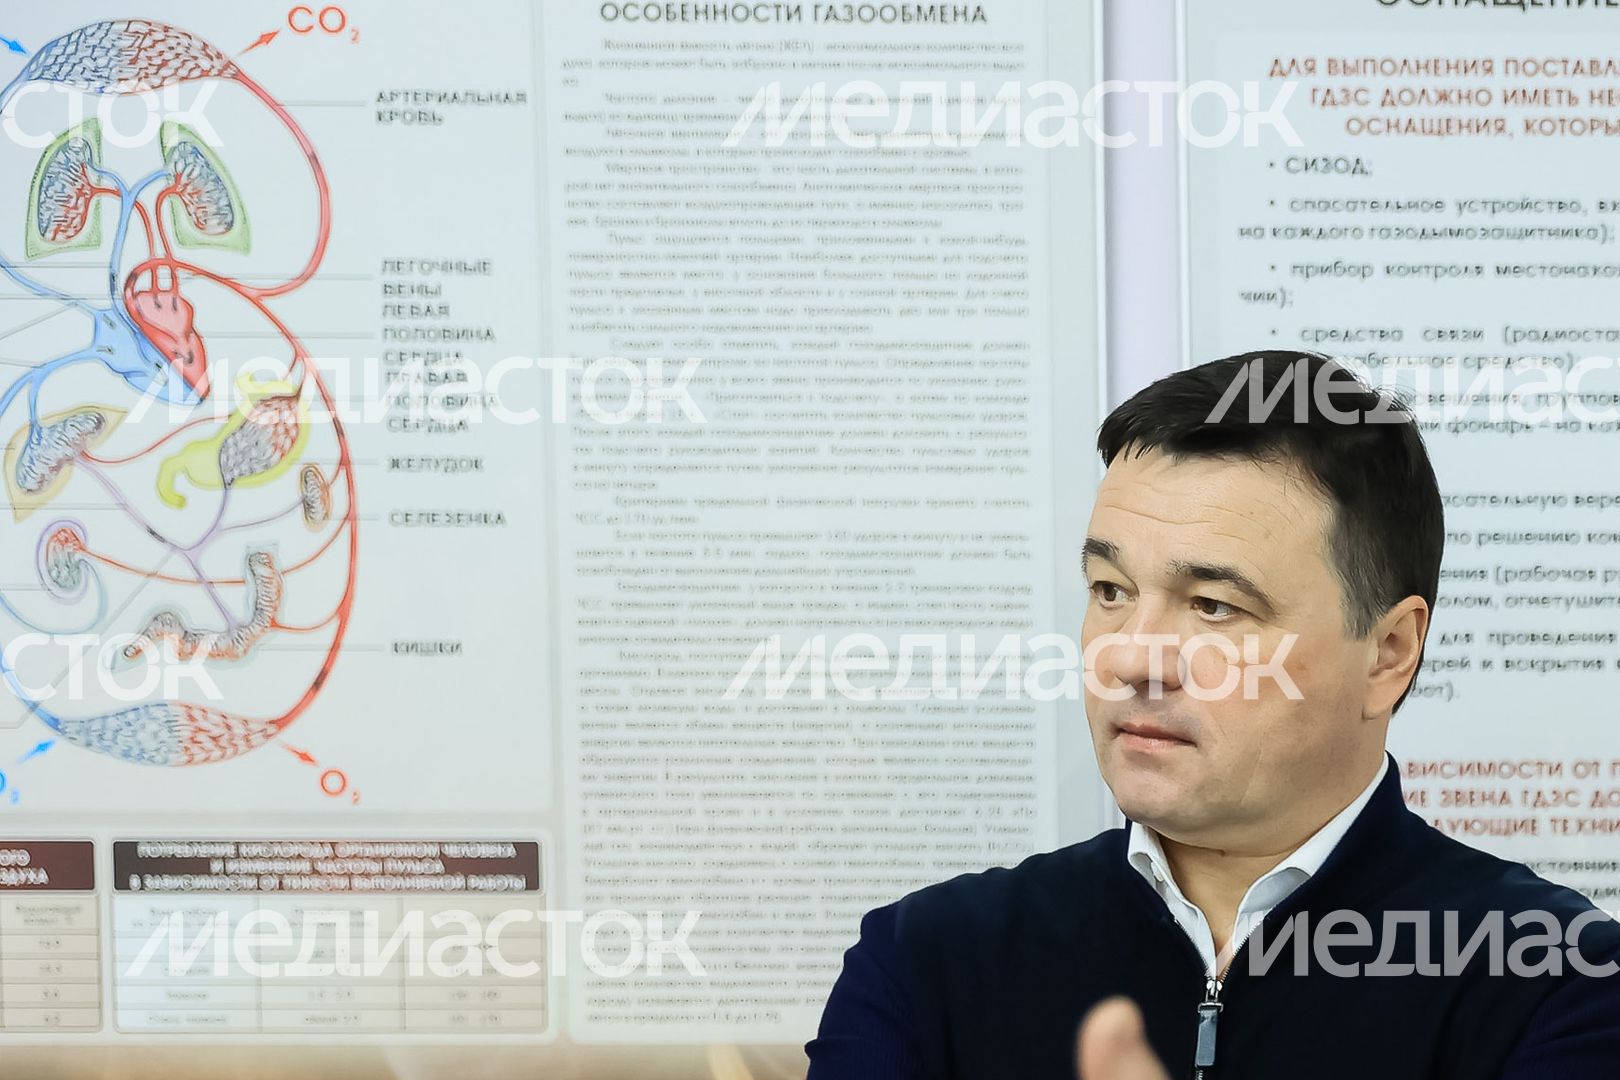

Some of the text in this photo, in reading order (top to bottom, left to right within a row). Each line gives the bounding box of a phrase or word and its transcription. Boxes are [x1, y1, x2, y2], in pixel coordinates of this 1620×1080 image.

[599, 1, 988, 24] ОСОБЕННОСТИ ГАЗООБМЕНА
[1268, 57, 1317, 79] ДЛЯ
[1326, 56, 1495, 78] ВЫПОЛНЕНИЯ
[1311, 86, 1370, 109] ГДЗС
[1379, 87, 1493, 109] ДОЛЖНО
[1502, 87, 1580, 108] ИМЕТЬ
[1402, 758, 1564, 780] ВИСИМОСТИ
